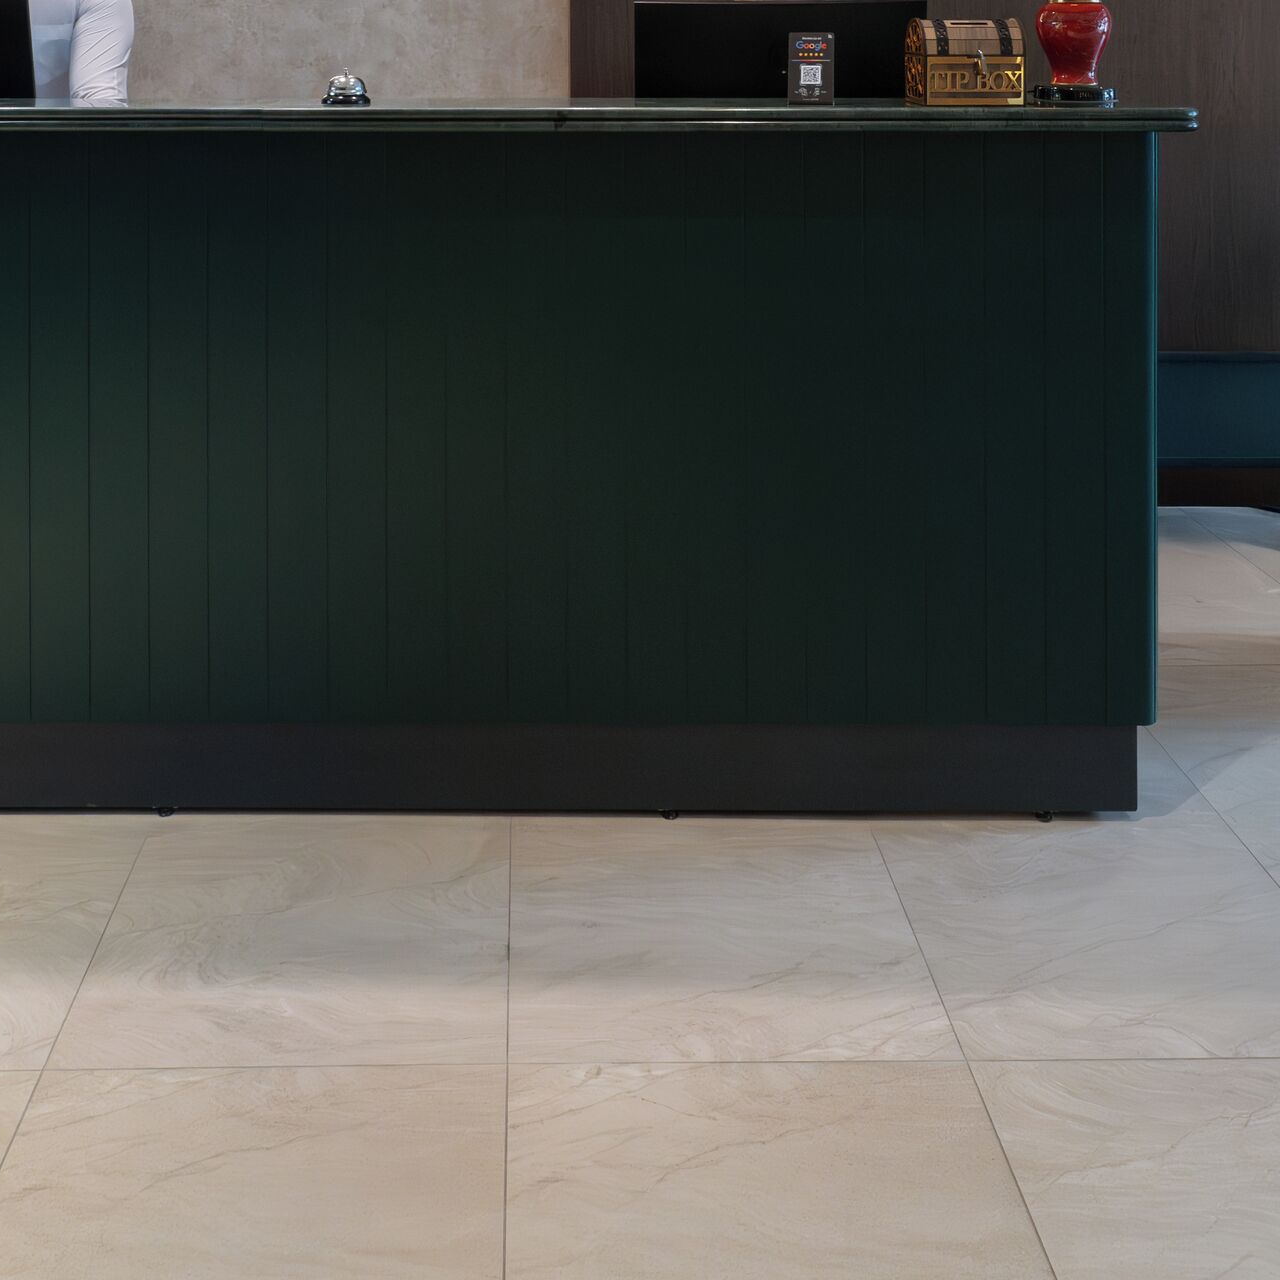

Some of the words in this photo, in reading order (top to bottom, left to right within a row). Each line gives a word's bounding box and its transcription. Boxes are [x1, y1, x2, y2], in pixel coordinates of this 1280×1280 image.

[795, 40, 827, 51] Google
[930, 70, 969, 92] TIP
[976, 70, 1022, 92] BOX
